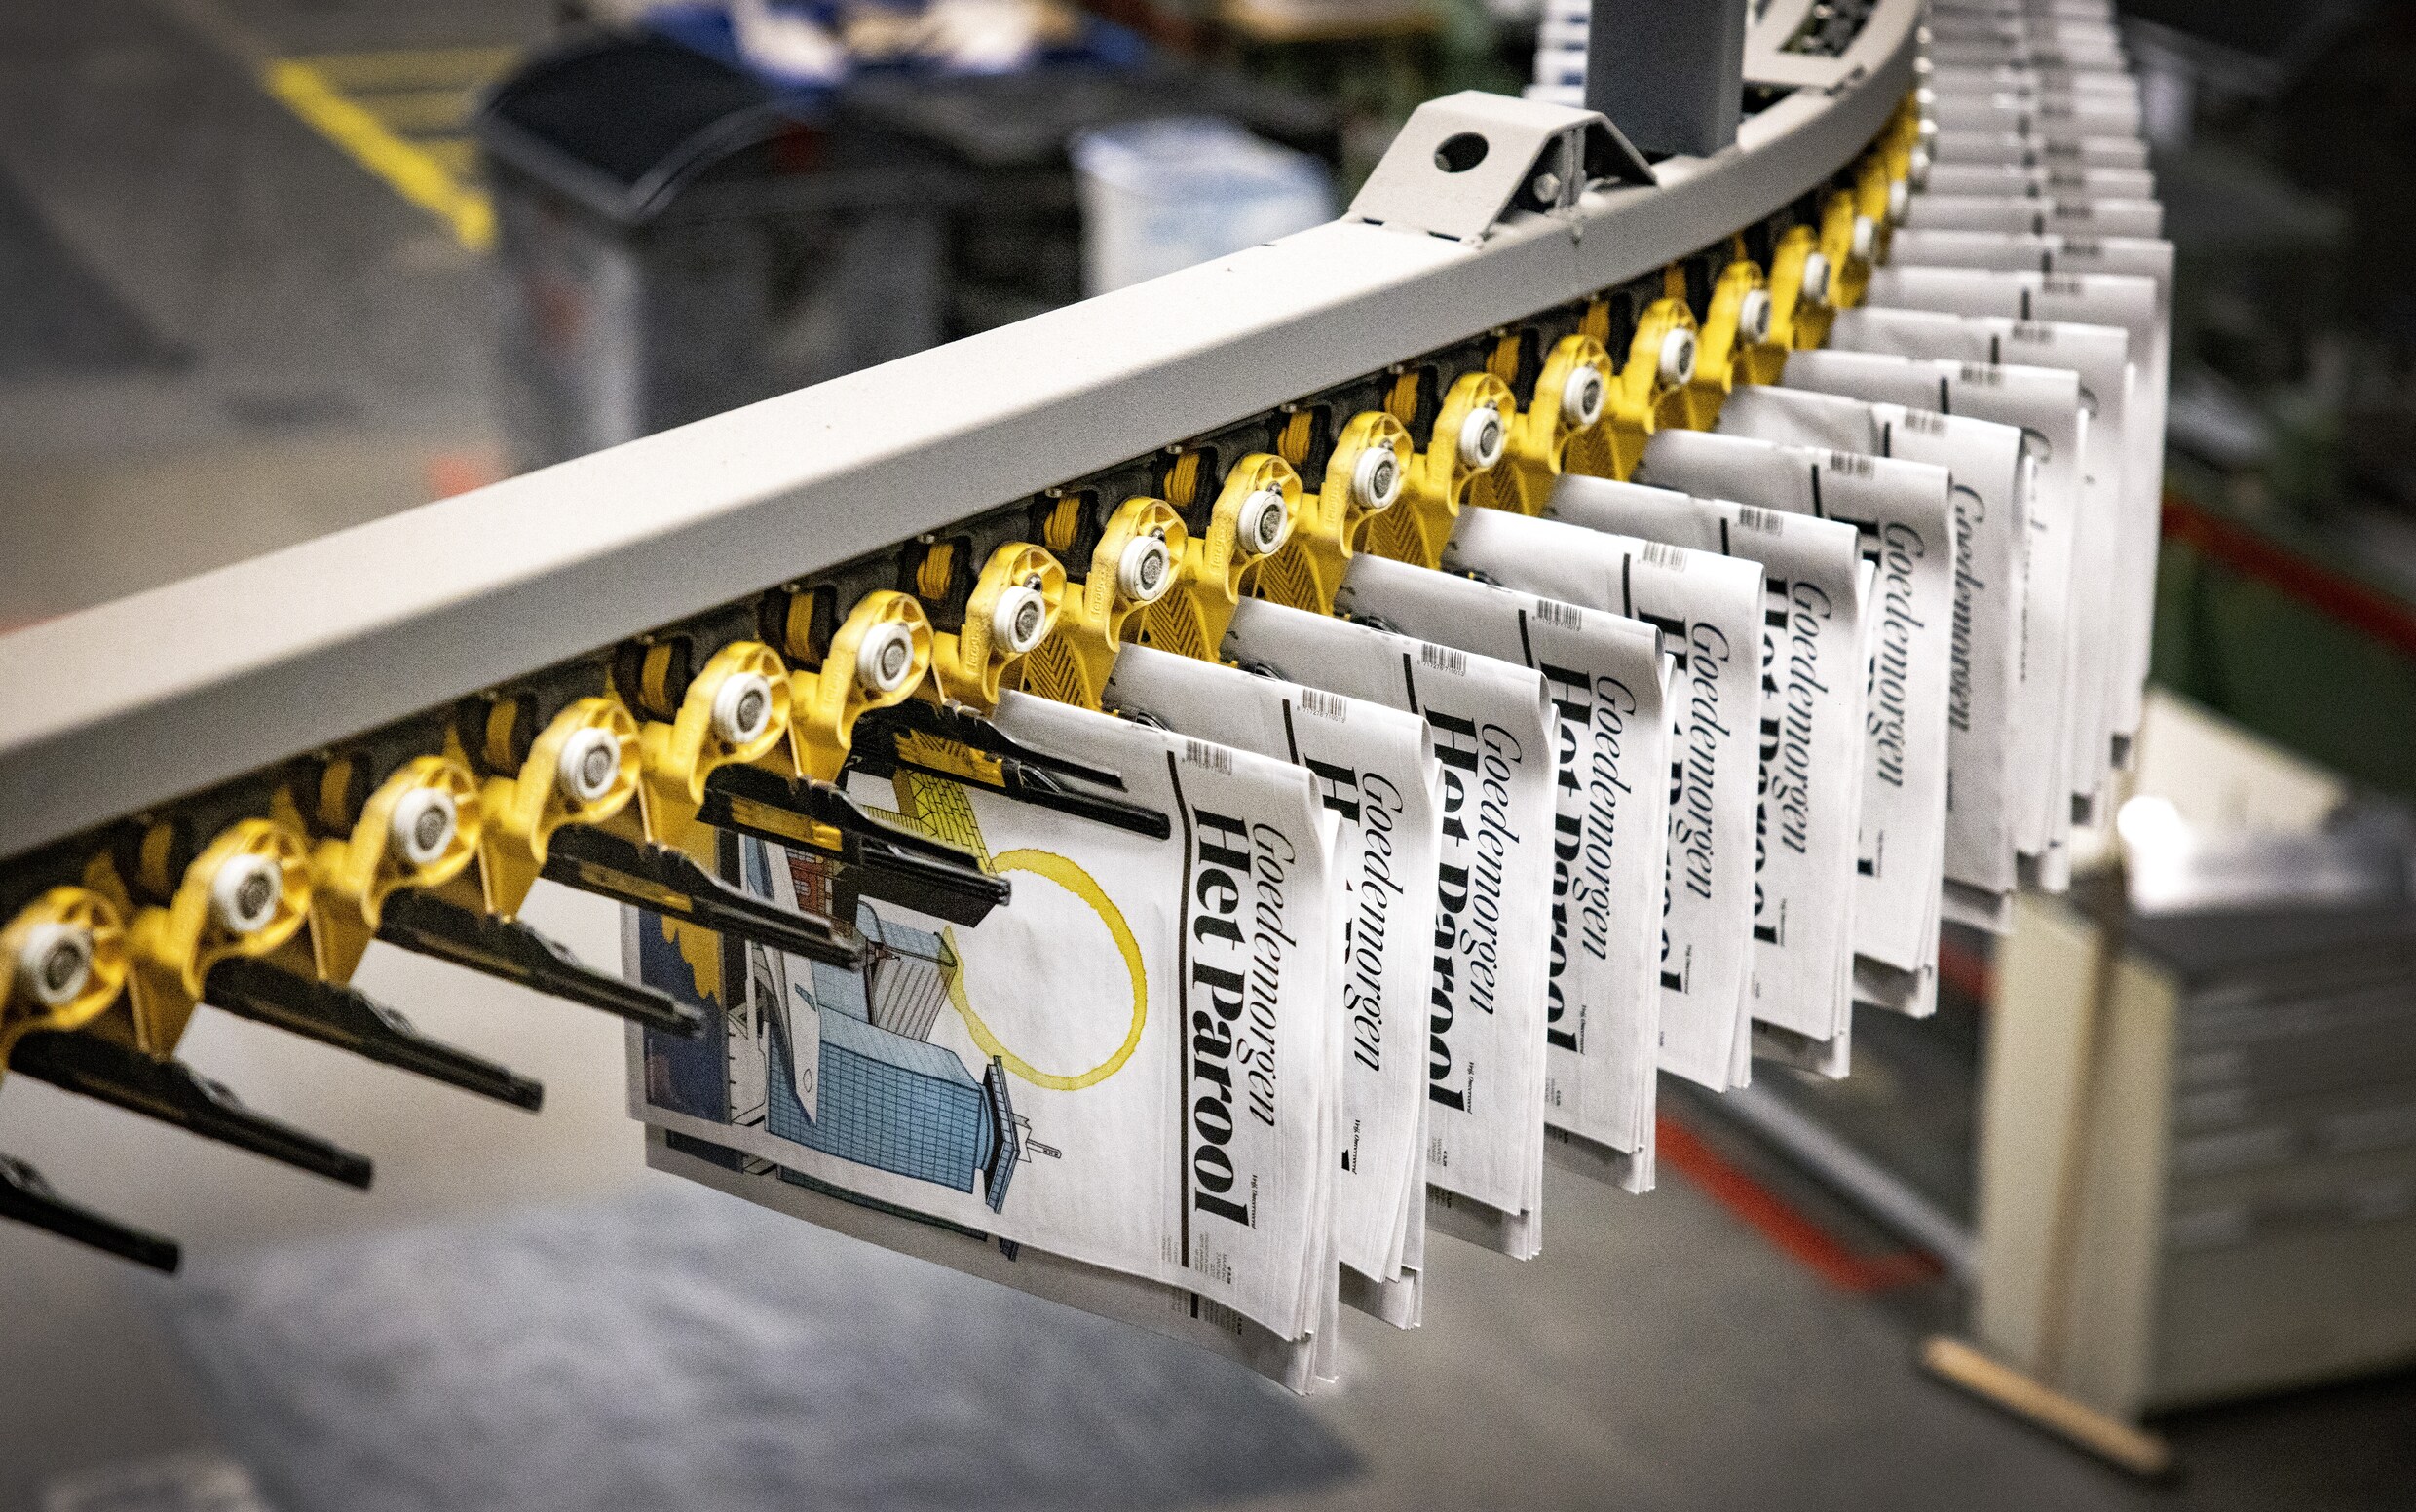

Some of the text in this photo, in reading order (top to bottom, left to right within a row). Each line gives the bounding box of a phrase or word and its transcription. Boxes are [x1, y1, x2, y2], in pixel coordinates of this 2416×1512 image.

[1676, 622, 1731, 899] Goedemorgen
[1772, 581, 1831, 854] Goedemorgen
[1867, 522, 1925, 788] Goedemorgen
[1191, 804, 1252, 951] Het
[1344, 772, 1404, 1072] Goedemorgen
[1460, 723, 1522, 1015] Goedemorgen
[1573, 675, 1637, 960] Goedemorgen
[1192, 956, 1250, 1228] Parool
[1236, 823, 1297, 1127] Goedemorgen
